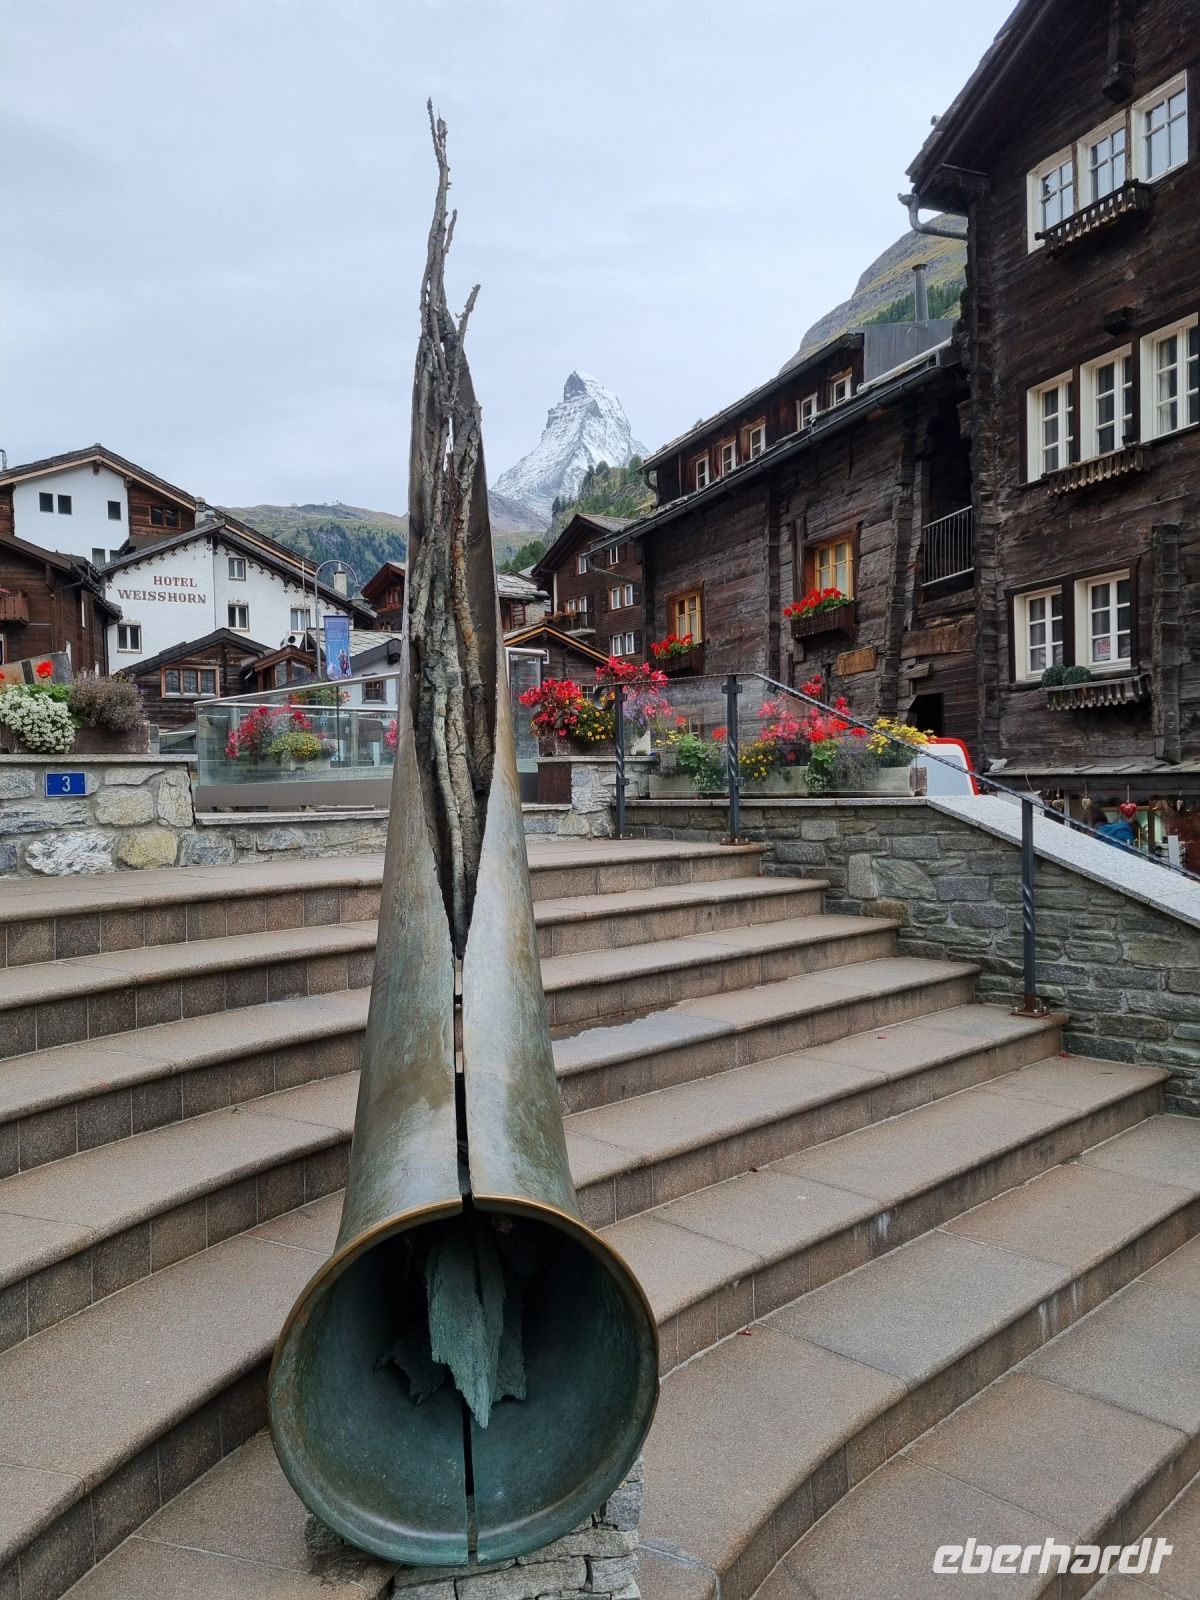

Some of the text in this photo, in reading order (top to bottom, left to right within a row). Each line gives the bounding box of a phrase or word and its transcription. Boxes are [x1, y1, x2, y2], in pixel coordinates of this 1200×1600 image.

[153, 575, 198, 588] HOTEL
[117, 589, 207, 604] WEISSHORN
[61, 775, 71, 792] 3
